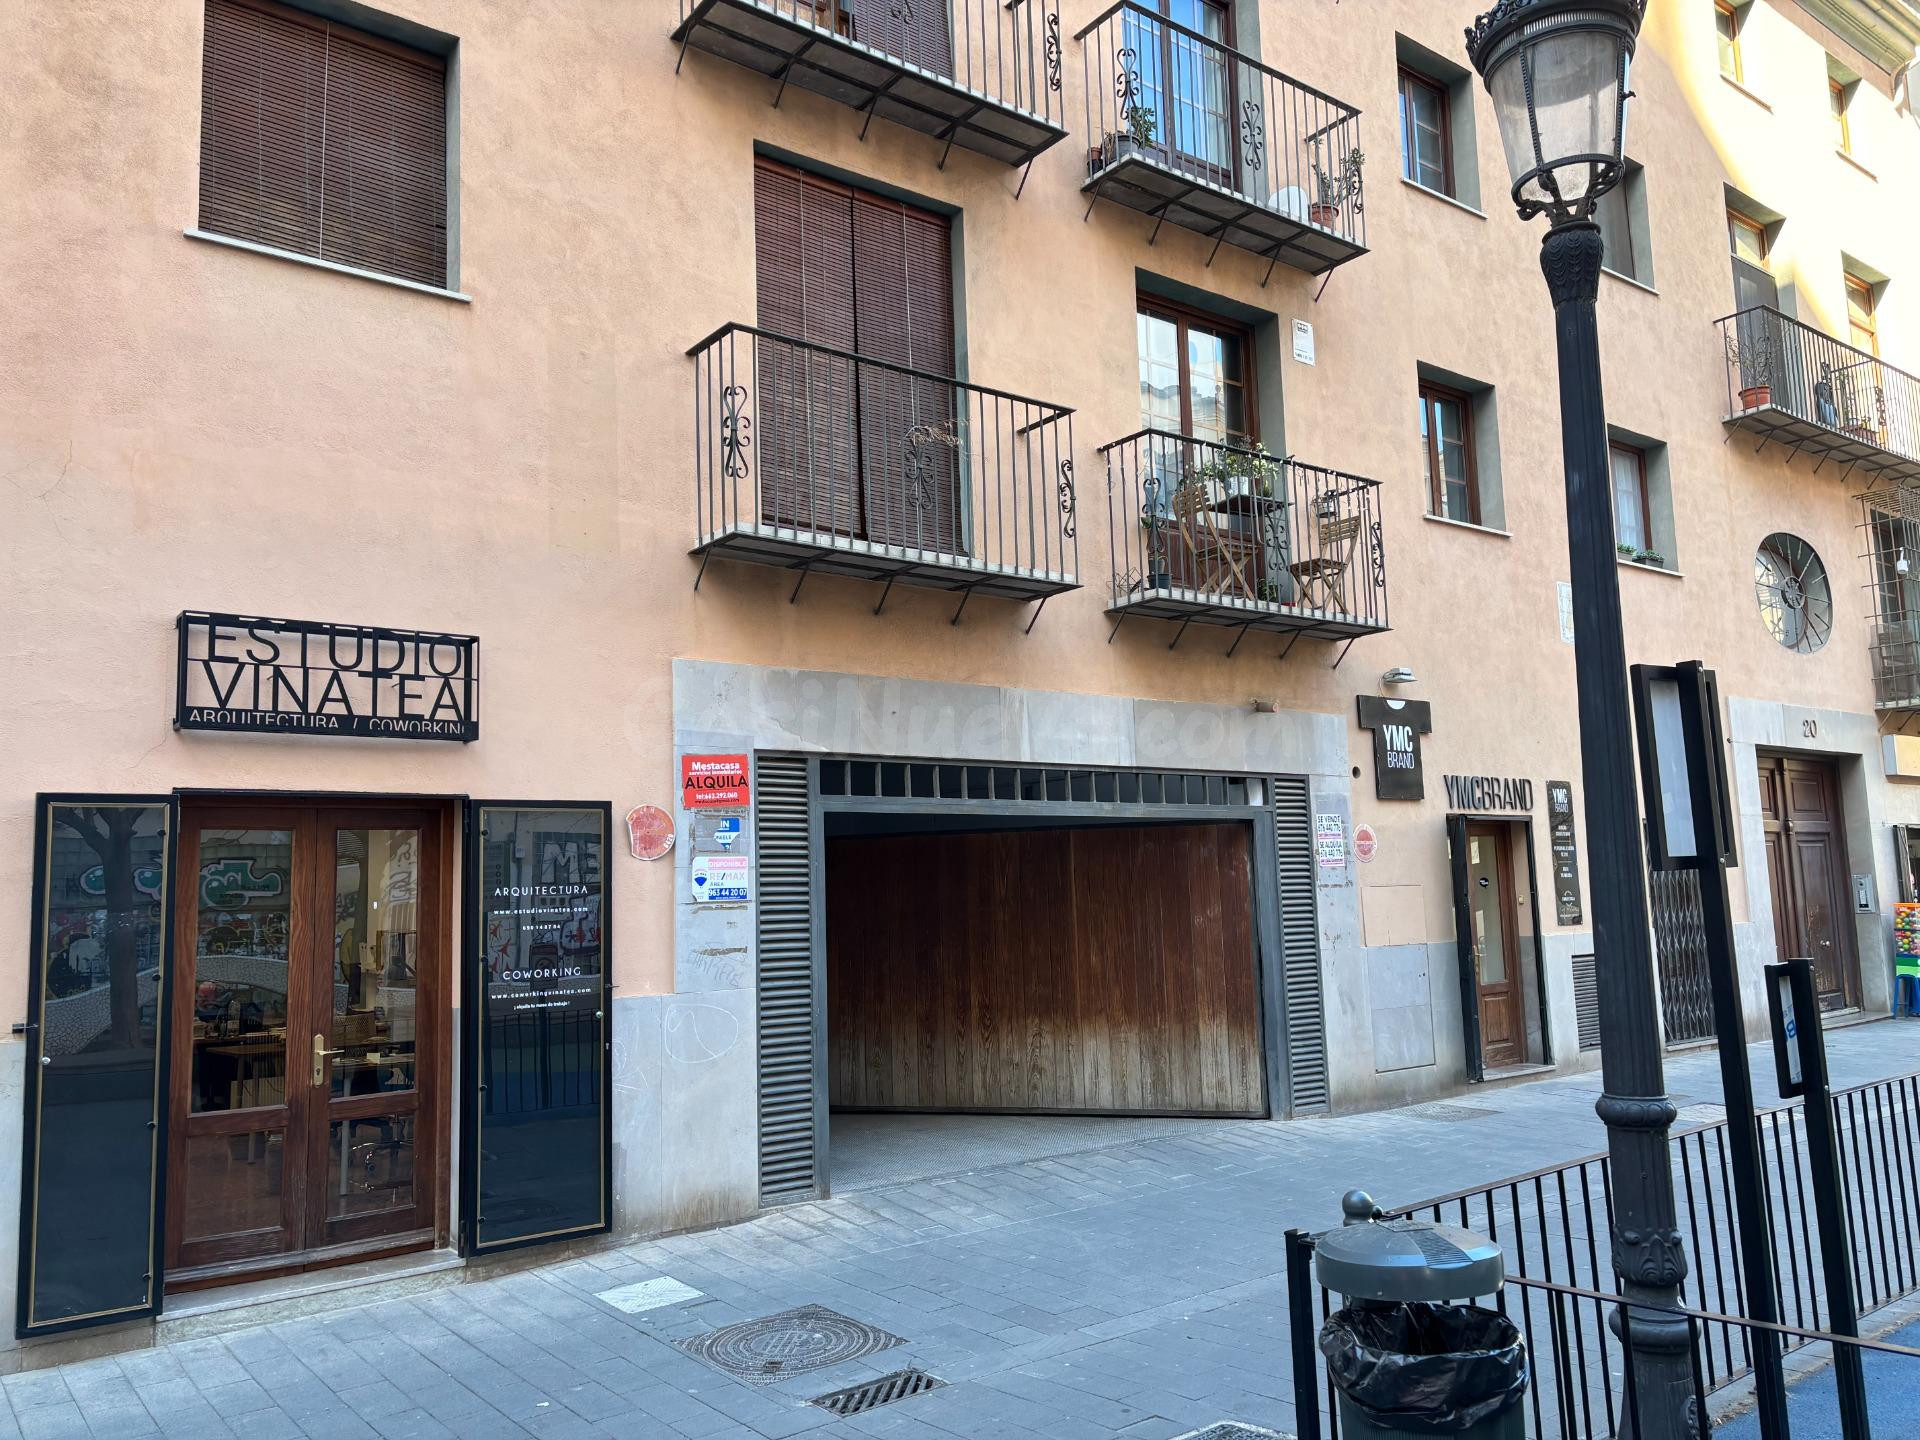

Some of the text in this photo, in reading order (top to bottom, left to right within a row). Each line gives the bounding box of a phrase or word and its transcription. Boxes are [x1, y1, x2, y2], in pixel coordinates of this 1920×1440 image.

[207, 613, 463, 677] ESTUDIO
[203, 660, 465, 720] VINATEA
[189, 708, 339, 728] ARQUITECTURA
[369, 718, 465, 734] COWORKIN
[1803, 719, 1818, 739] 20
[1382, 724, 1414, 752] YMC
[691, 761, 740, 771] Mestacasa
[1387, 752, 1415, 769] BRAND
[685, 776, 749, 789] ALQUILA
[1552, 788, 1568, 804] YMC
[1554, 803, 1569, 813] BRAND
[709, 872, 745, 881] RE/MAX
[494, 885, 588, 897] ARQUITECTURA
[503, 967, 581, 980] COWORKING
